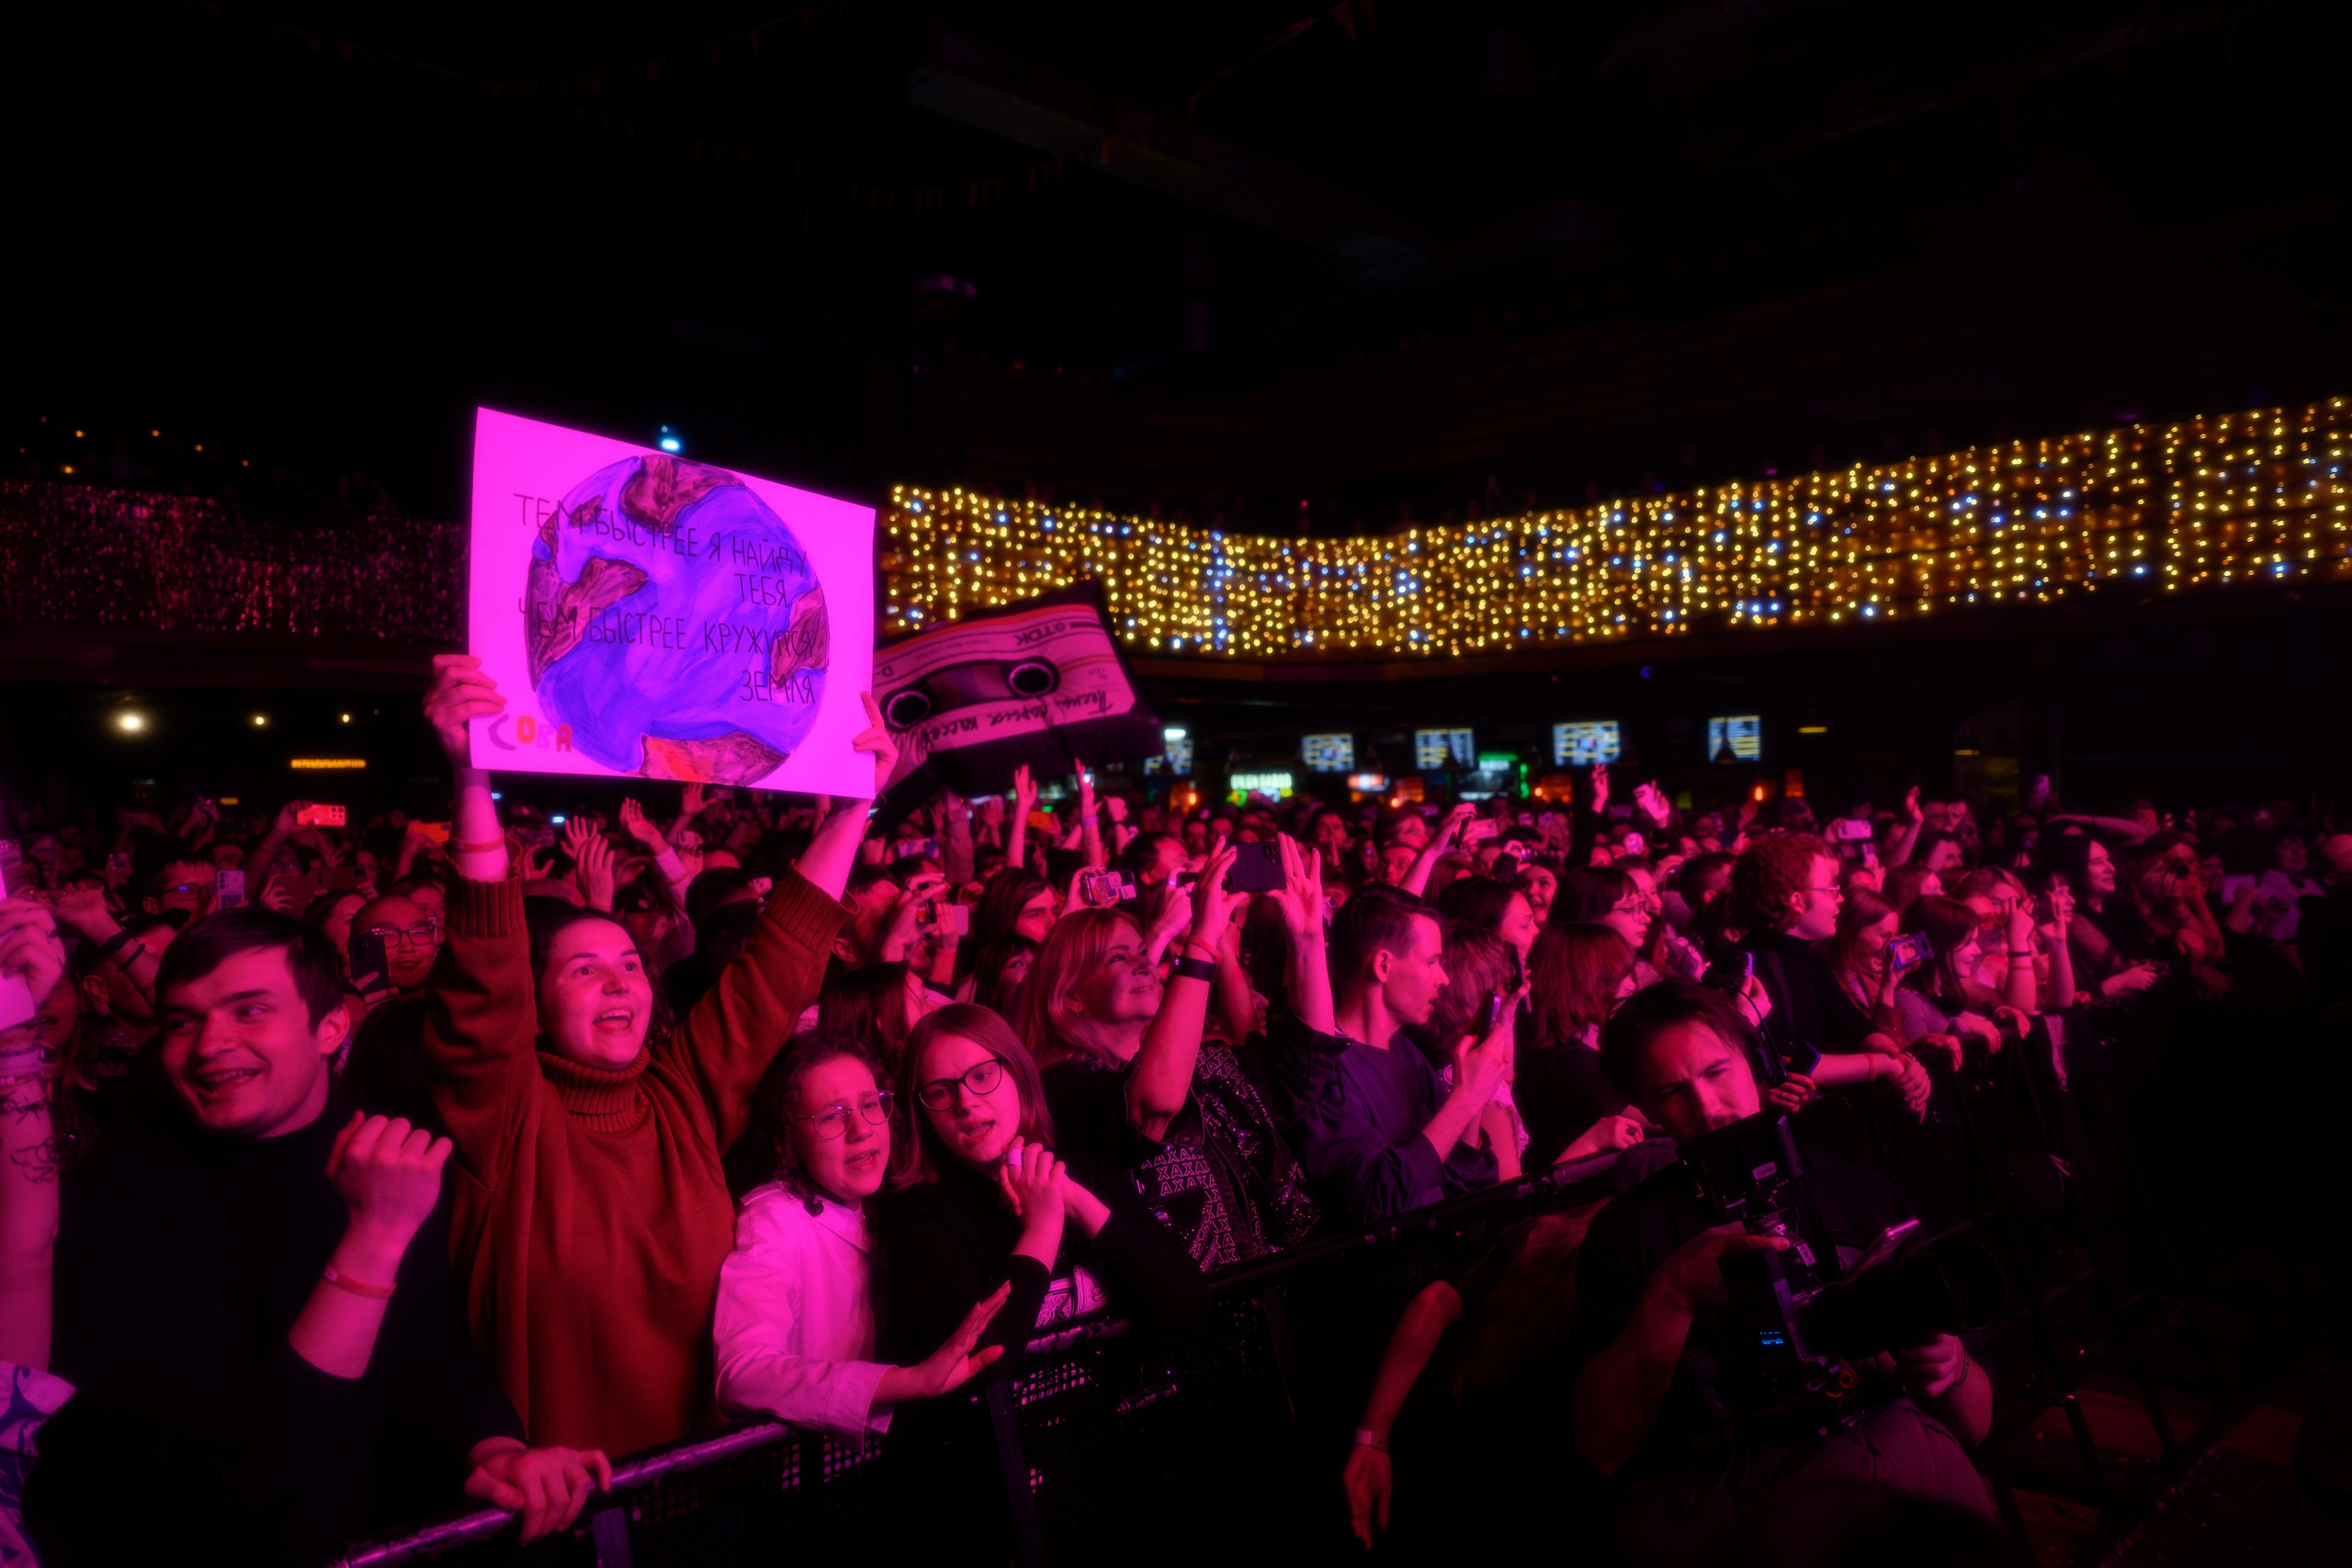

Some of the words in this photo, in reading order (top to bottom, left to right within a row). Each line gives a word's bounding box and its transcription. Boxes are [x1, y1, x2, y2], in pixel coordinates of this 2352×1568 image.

[514, 492, 583, 535] ТЕМ
[594, 507, 698, 557] БЫСТРЕЕ
[708, 532, 720, 561] Я
[732, 535, 807, 578] НАЙДУ
[734, 573, 788, 608] ТЕБЯ
[589, 606, 687, 650] БЫСТРЕЕ
[704, 621, 813, 658] КРУЖИТСЯ
[1014, 625, 1057, 646] TDK
[741, 670, 816, 705] ЗЕМЛЯ
[488, 713, 572, 752] СОВА
